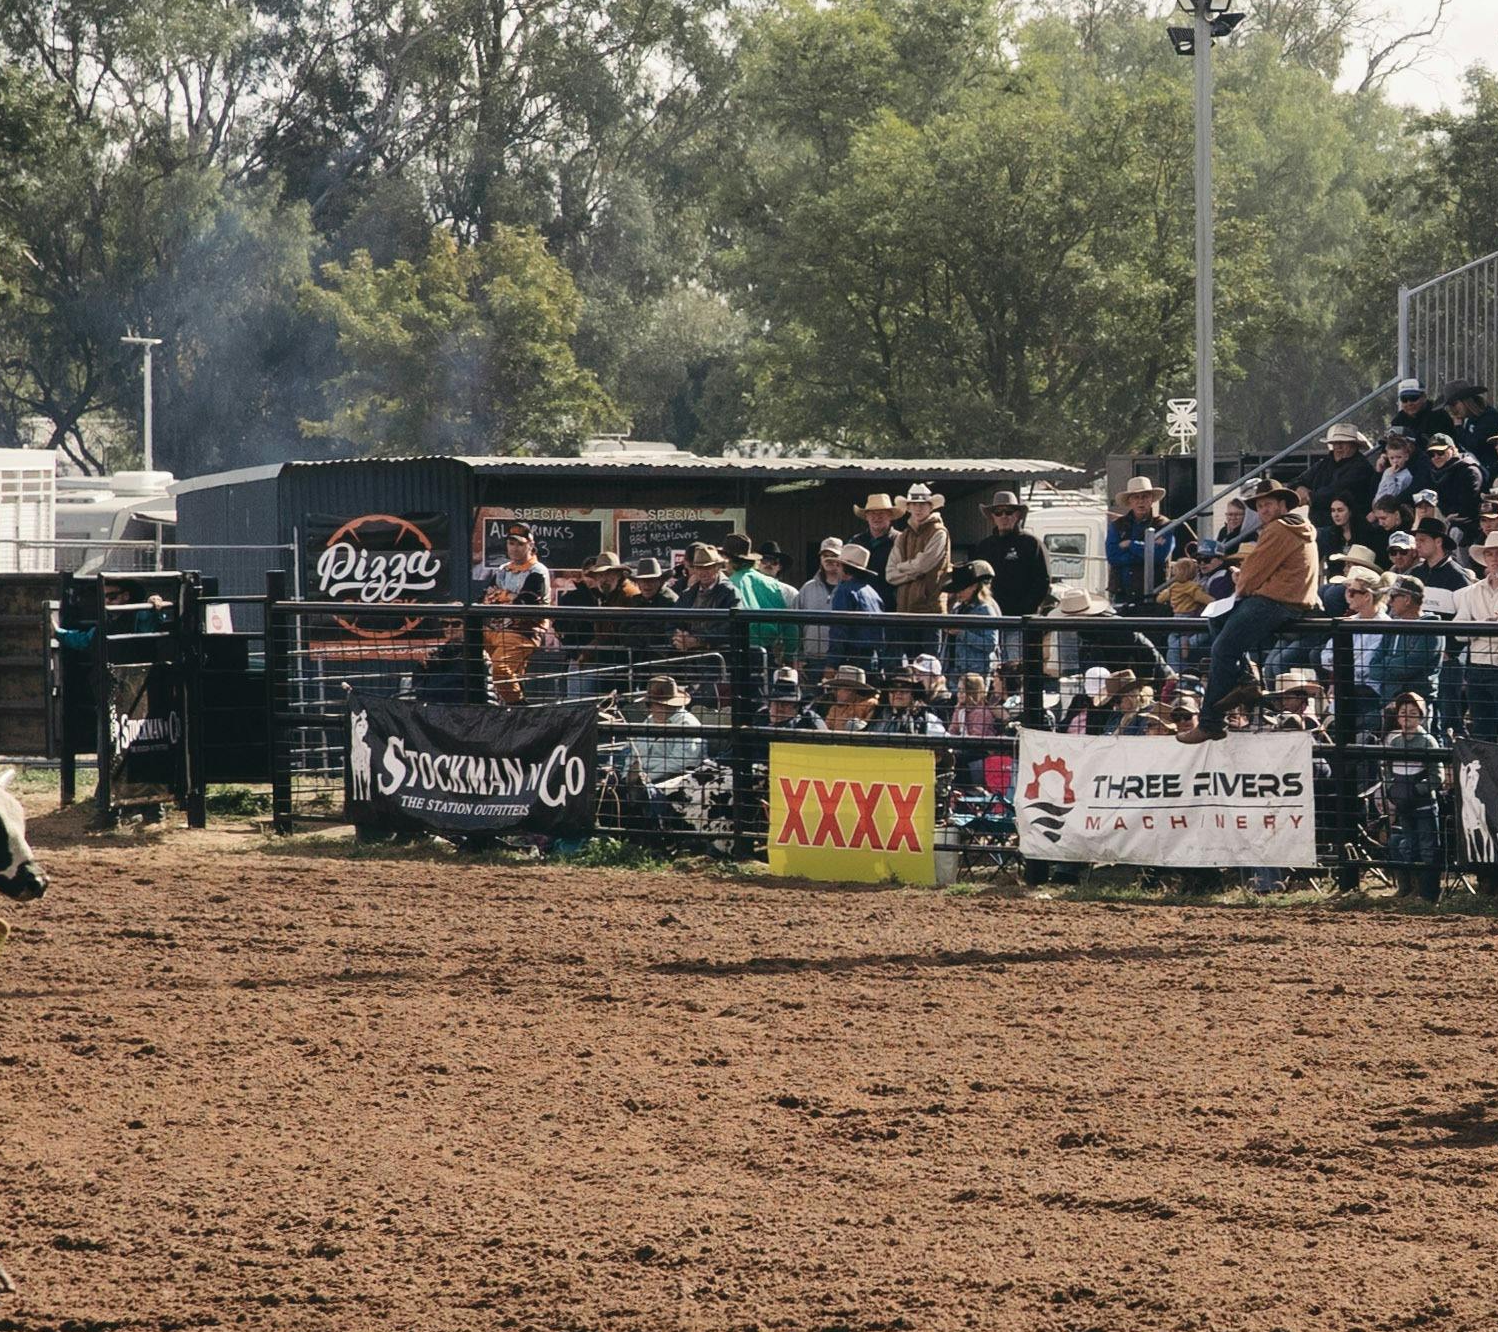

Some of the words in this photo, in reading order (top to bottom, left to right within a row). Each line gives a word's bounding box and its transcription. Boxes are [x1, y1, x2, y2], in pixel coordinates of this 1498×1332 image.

[514, 508, 571, 520] SPECIAL
[648, 509, 704, 521] SPECIAL
[317, 542, 441, 603] Pizza
[377, 735, 524, 796] STOCKMAN
[1092, 774, 1185, 799] THREE
[1193, 772, 1304, 797] RIVERS
[400, 795, 424, 810] THE
[426, 799, 473, 815] STATION
[474, 803, 530, 817] OUTFITTERS
[776, 776, 925, 855] XXXX
[1085, 814, 1304, 831] MACHINERY
